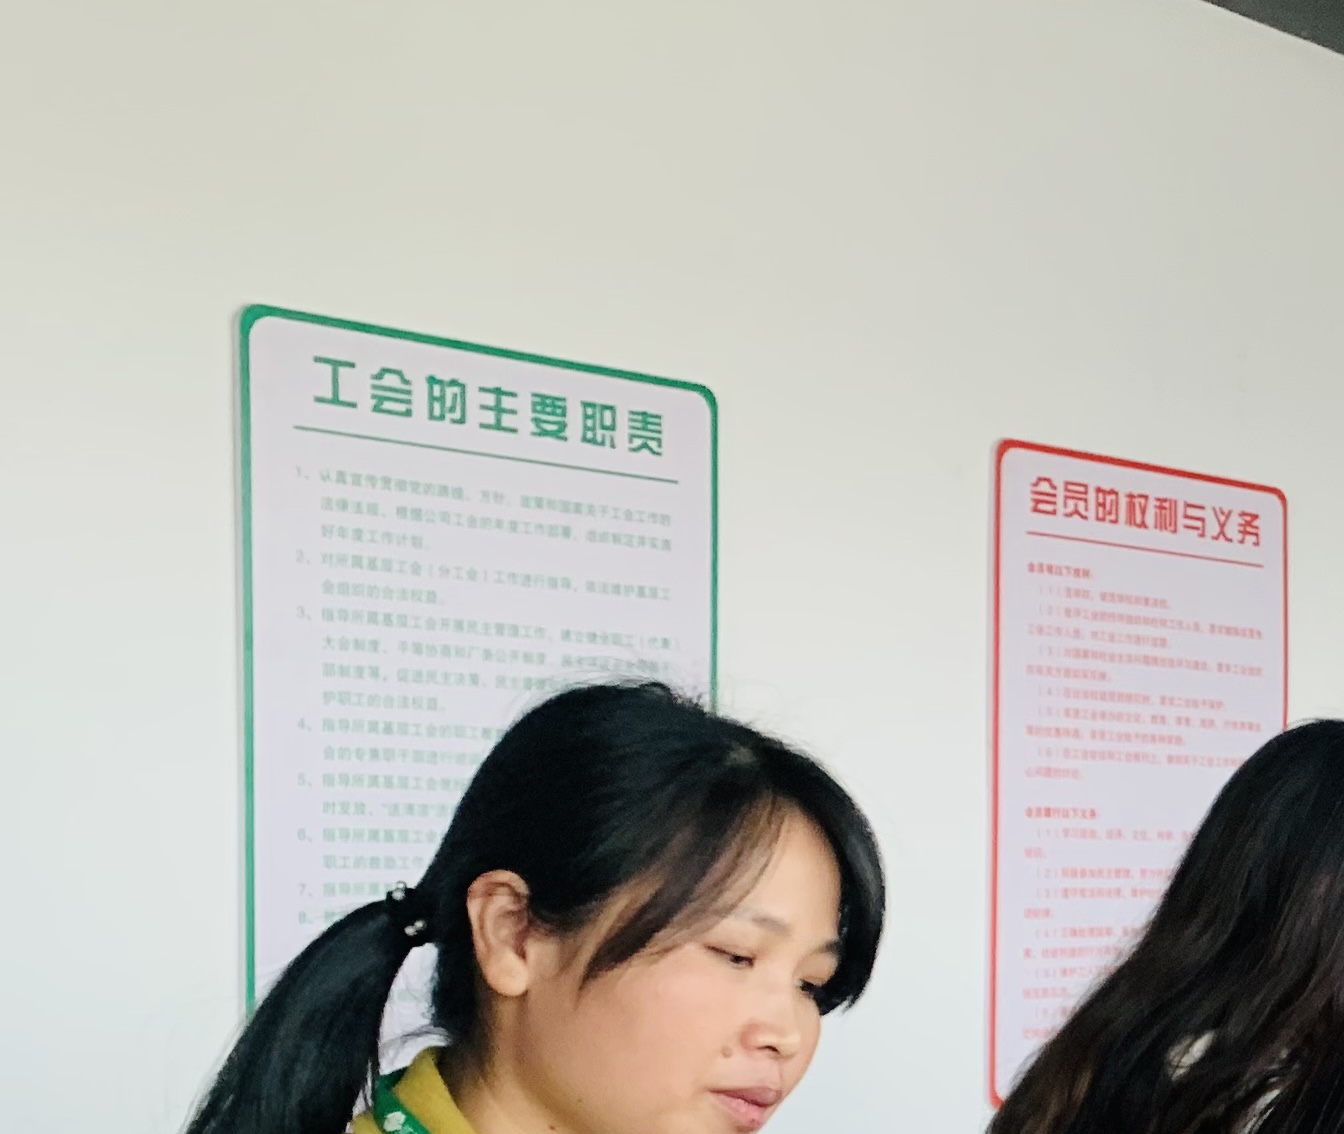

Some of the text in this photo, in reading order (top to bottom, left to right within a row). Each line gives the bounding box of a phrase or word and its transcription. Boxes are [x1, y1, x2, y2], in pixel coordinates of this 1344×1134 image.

[312, 355, 664, 456] 工会的主要职责
[1030, 476, 1261, 547] 会员的权利与义务
